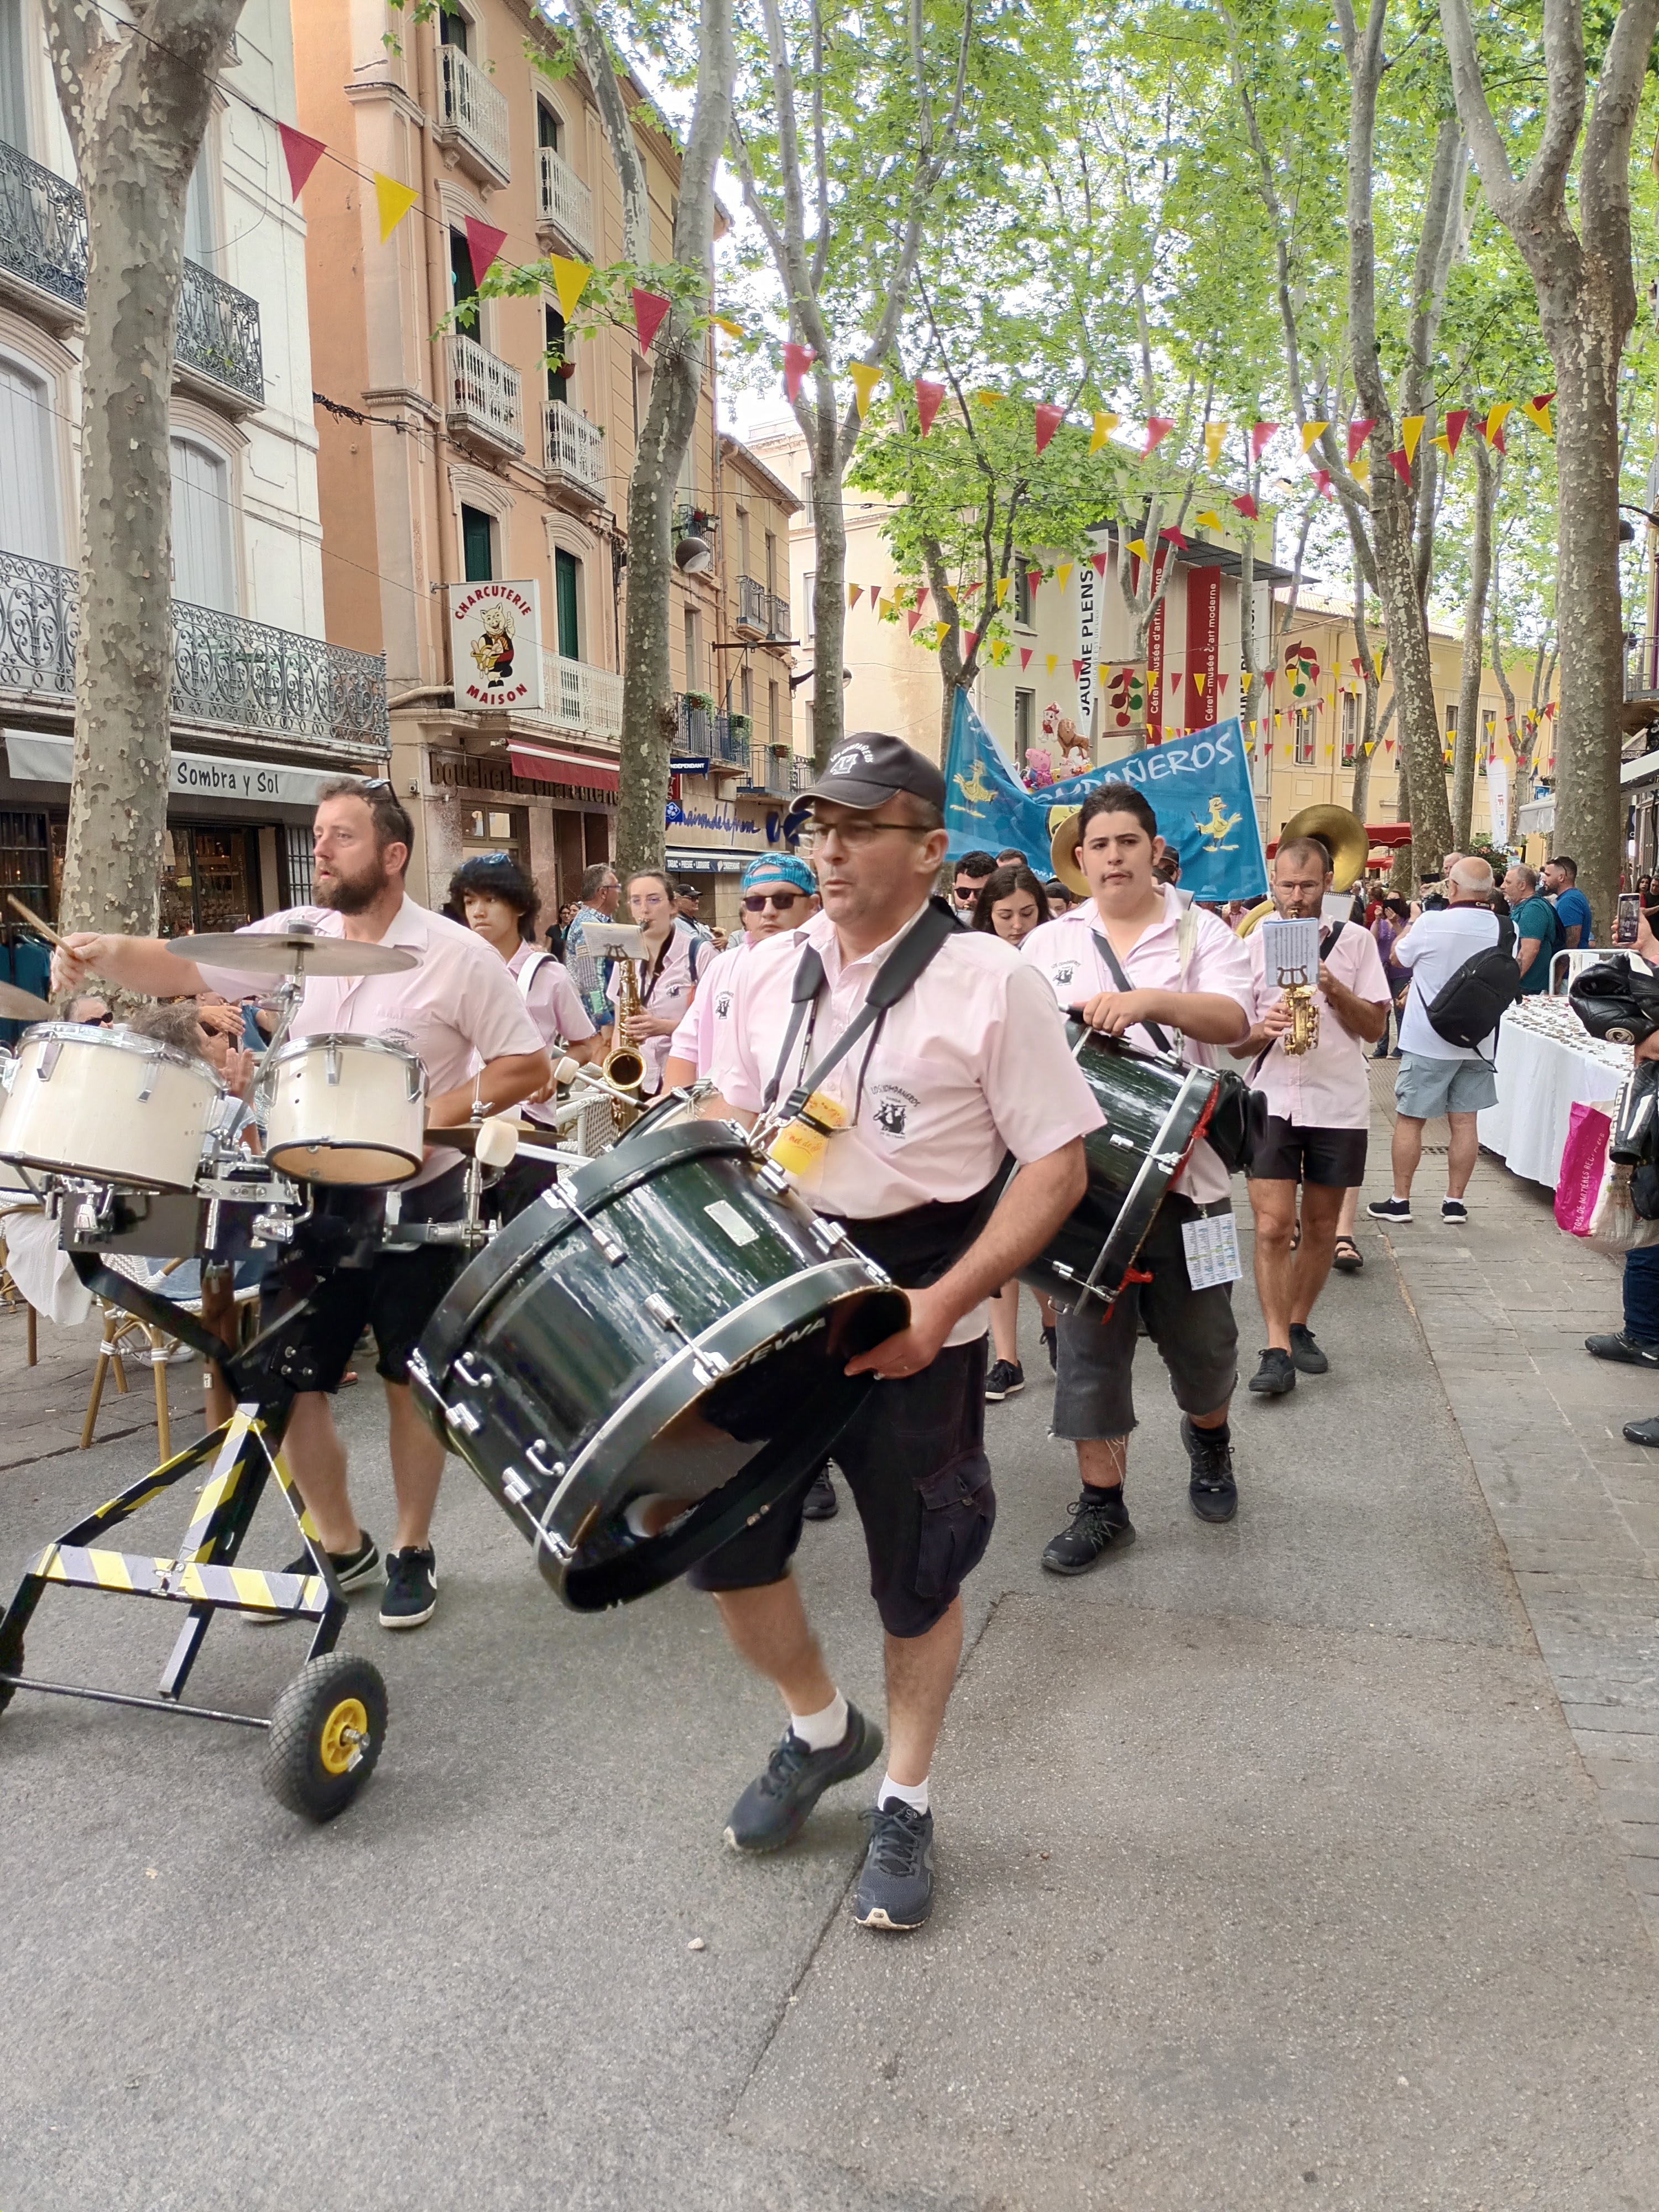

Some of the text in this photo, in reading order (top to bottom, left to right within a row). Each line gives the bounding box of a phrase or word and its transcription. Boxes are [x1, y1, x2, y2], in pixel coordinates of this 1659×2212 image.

[455, 586, 531, 620] CHARCUTERIE
[1208, 583, 1217, 630] moderne
[1080, 568, 1094, 717] JAUME PLENS
[1208, 630, 1216, 653] d'art
[466, 683, 528, 705] MAISON
[178, 761, 279, 796] Sombra y Sol
[870, 1084, 881, 1094] LOS
[1576, 1206, 1585, 1214] DE
